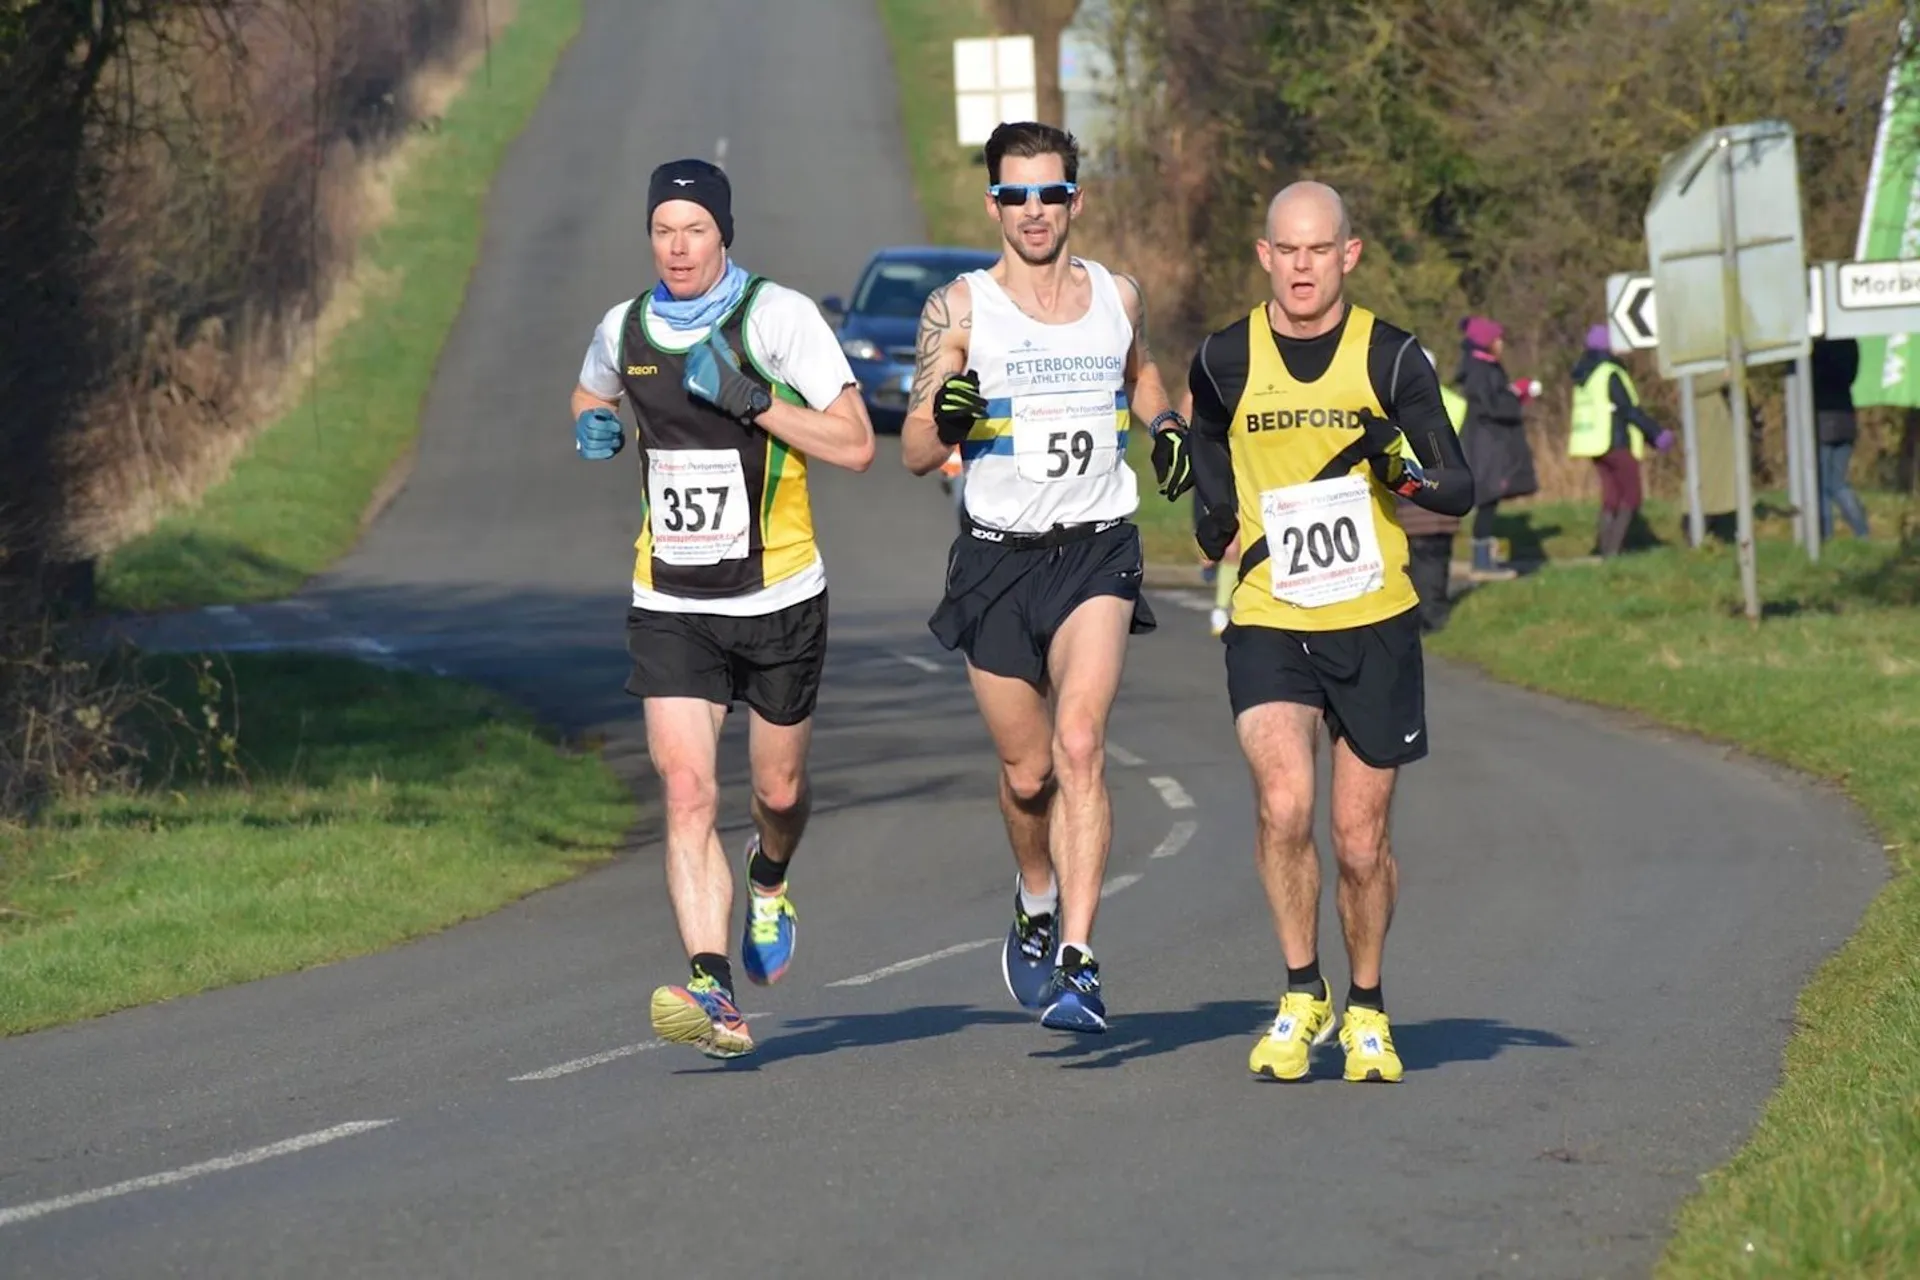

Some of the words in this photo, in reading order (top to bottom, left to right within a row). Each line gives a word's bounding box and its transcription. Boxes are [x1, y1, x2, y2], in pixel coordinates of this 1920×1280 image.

[1006, 356, 1122, 376] PETERBOROUGH
[1031, 373, 1077, 384] ATHLETIC
[1079, 371, 1104, 381] CLUB
[1246, 408, 1361, 433] BEDFORD
[1046, 430, 1093, 478] 59
[663, 486, 729, 532] 357
[971, 527, 1005, 542] 2XU
[1283, 516, 1360, 576] 200
